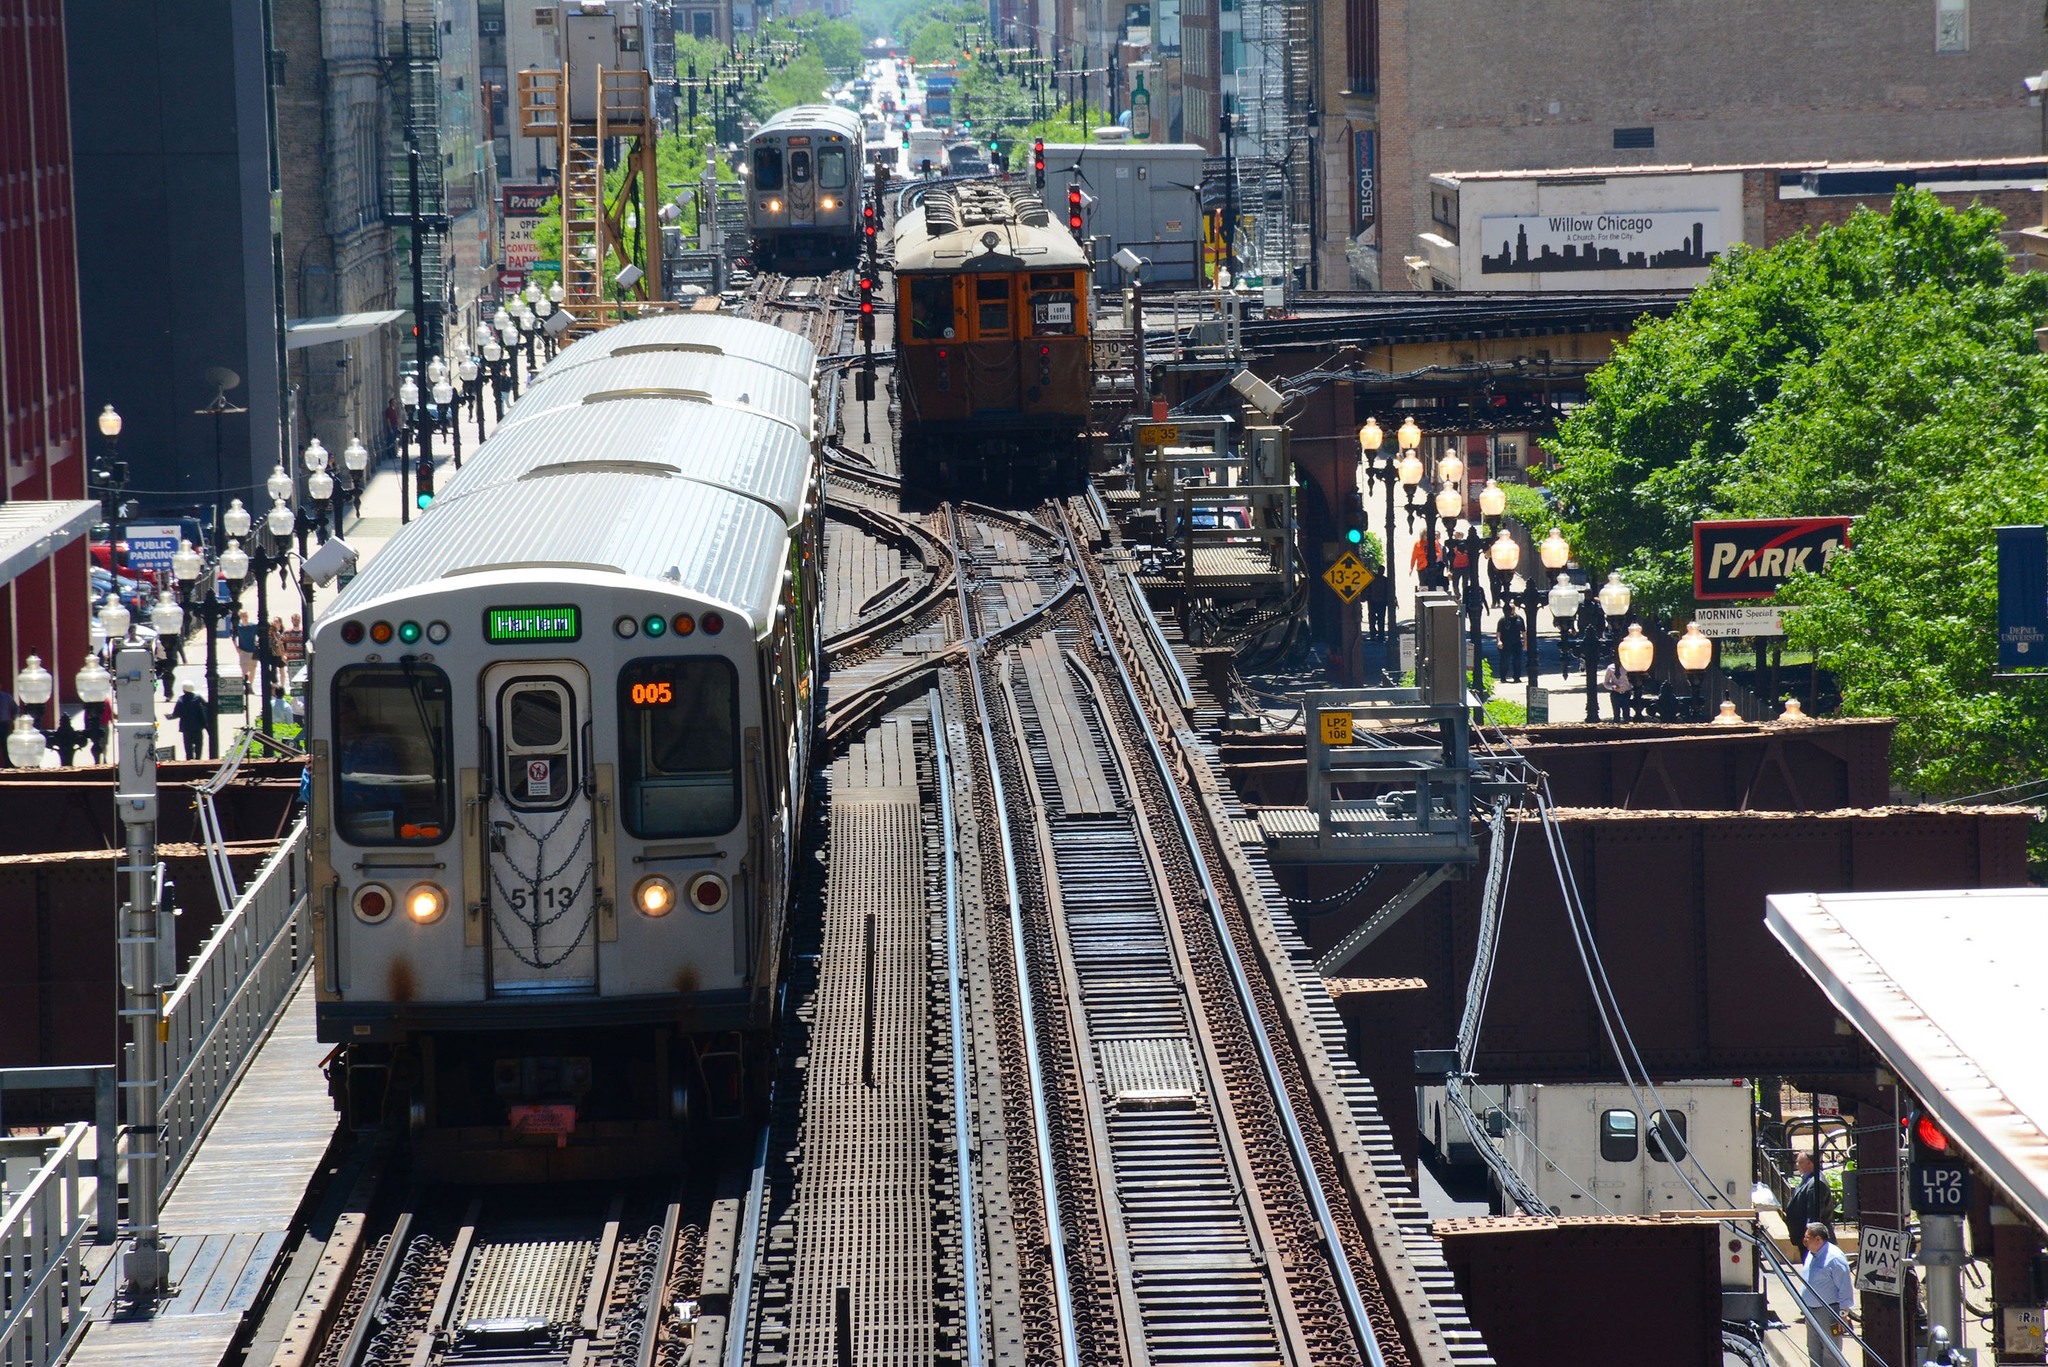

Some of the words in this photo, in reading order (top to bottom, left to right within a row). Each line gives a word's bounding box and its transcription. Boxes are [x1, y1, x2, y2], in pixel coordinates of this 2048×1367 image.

[1361, 169, 1374, 220] HOSTEL
[510, 196, 542, 208] PARK
[1549, 217, 1593, 232] Willow
[1597, 216, 1653, 234] Chicago
[511, 231, 523, 240] 24
[1598, 233, 1608, 241] For
[1621, 232, 1635, 241] City.
[1107, 343, 1119, 353] 10
[1160, 428, 1175, 439] 35
[135, 541, 171, 550] PUBLIC
[130, 551, 176, 560] PARKING
[1708, 542, 1813, 579] PARK
[1820, 538, 1838, 575] 1
[1698, 610, 1743, 620] MORNING
[1746, 609, 1773, 618] Special
[498, 615, 568, 632] Harlem
[1726, 628, 1740, 636] FRI
[632, 683, 672, 704] 005
[1327, 718, 1347, 728] LP2
[1328, 730, 1347, 739] 108
[512, 887, 574, 909] 5113
[1923, 1170, 1962, 1187] LP2
[1924, 1187, 1961, 1204] 110
[1867, 1233, 1900, 1252] ONE
[1865, 1249, 1900, 1268] WAY
